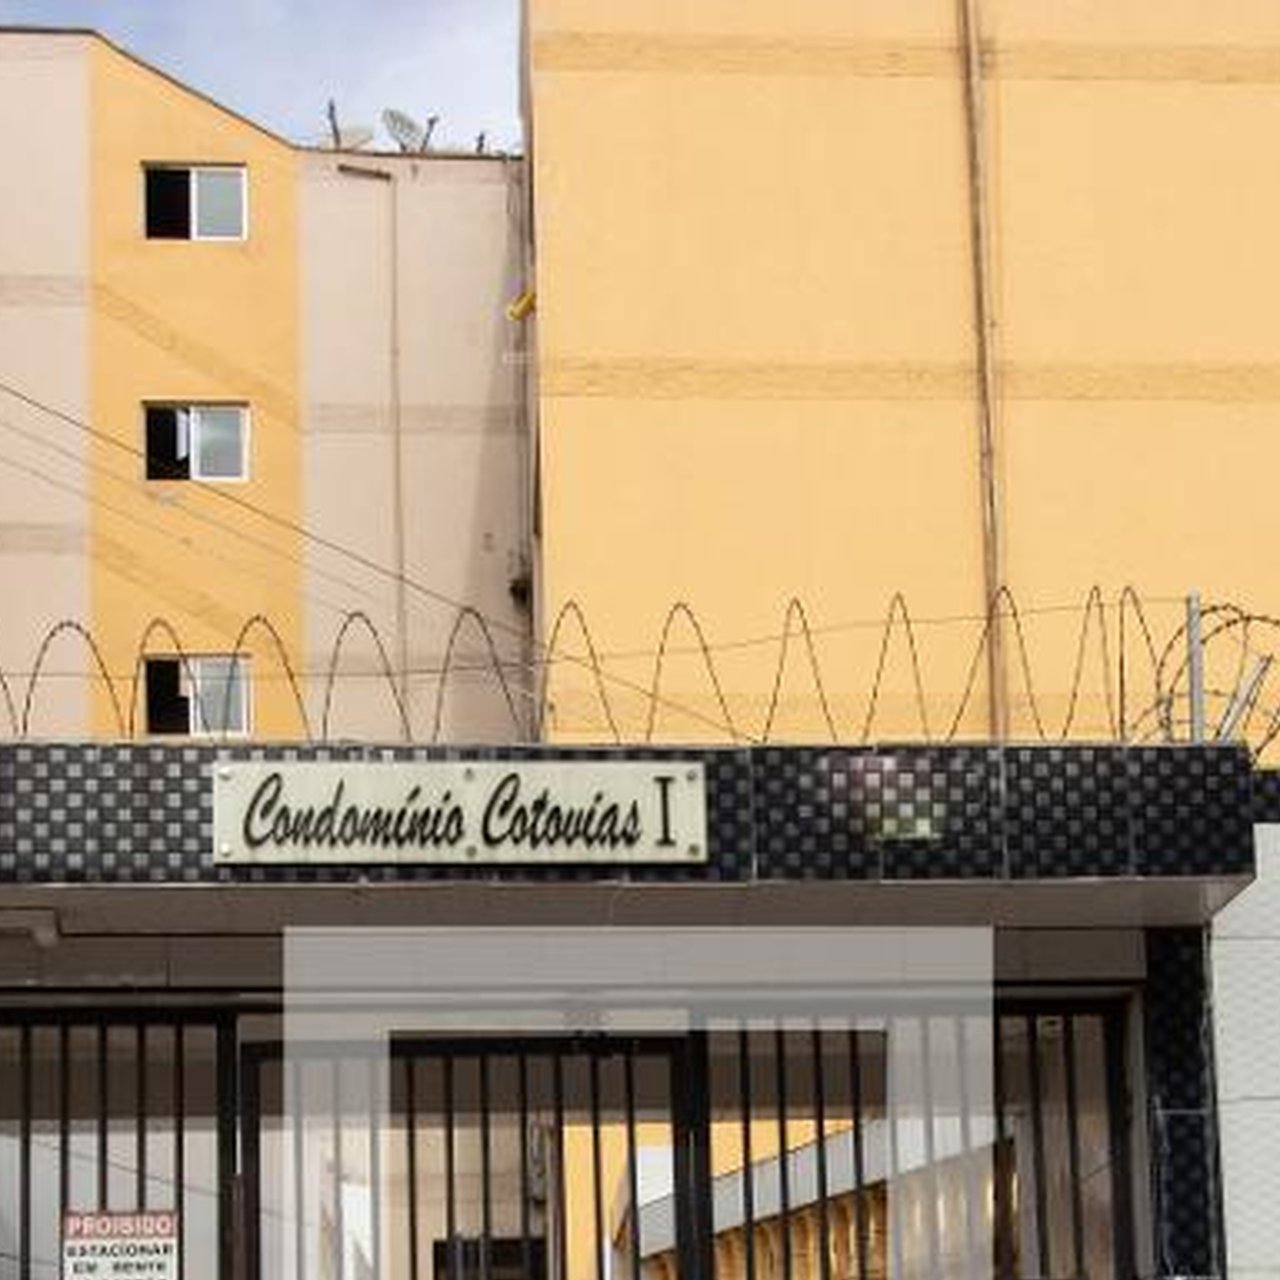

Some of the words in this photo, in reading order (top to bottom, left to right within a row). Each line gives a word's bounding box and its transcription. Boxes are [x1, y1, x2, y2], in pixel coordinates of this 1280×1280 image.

[243, 772, 465, 848] Condomínio
[482, 772, 642, 849] Cotovias
[652, 775, 676, 846] I
[67, 1214, 172, 1236] PROIBIDO
[66, 1243, 174, 1258] ESTACIONAR
